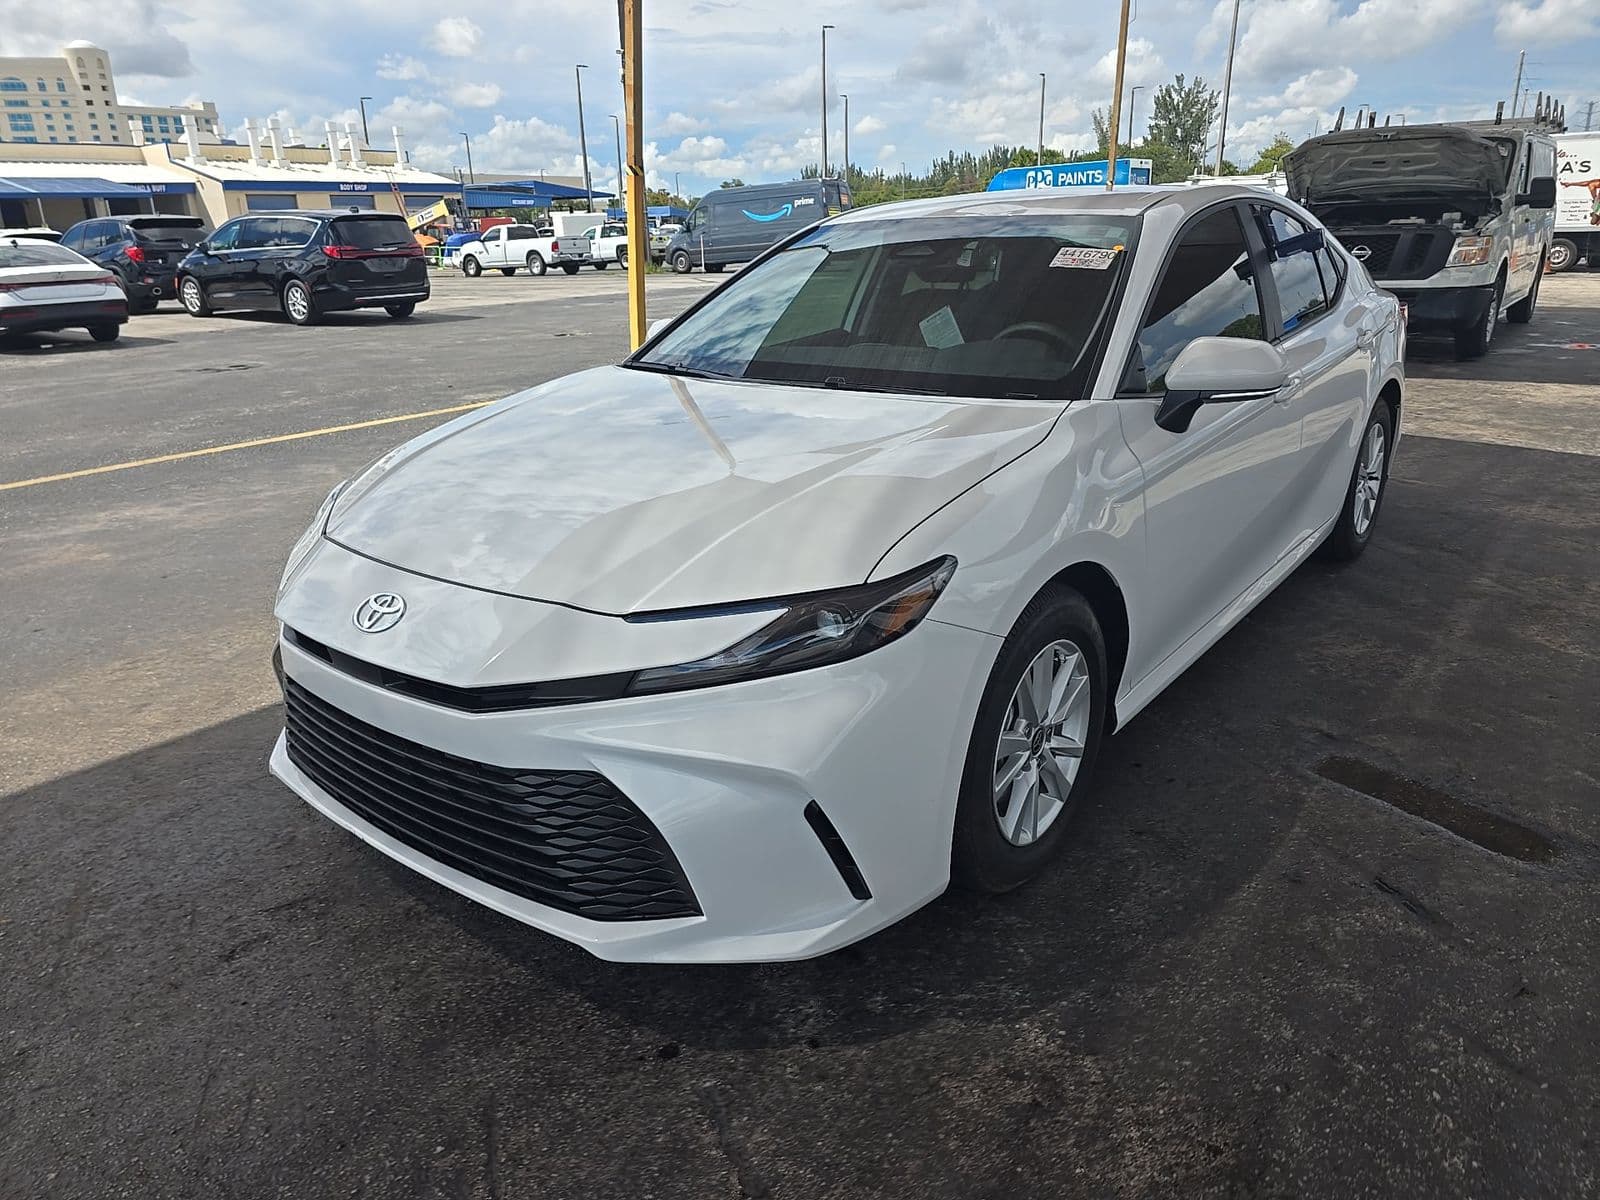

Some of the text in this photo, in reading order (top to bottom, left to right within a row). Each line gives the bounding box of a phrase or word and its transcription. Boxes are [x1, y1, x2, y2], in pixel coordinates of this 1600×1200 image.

[1026, 170, 1103, 189] PPG PAINTS
[794, 197, 814, 208] prime
[1061, 250, 1116, 260] 4416790
